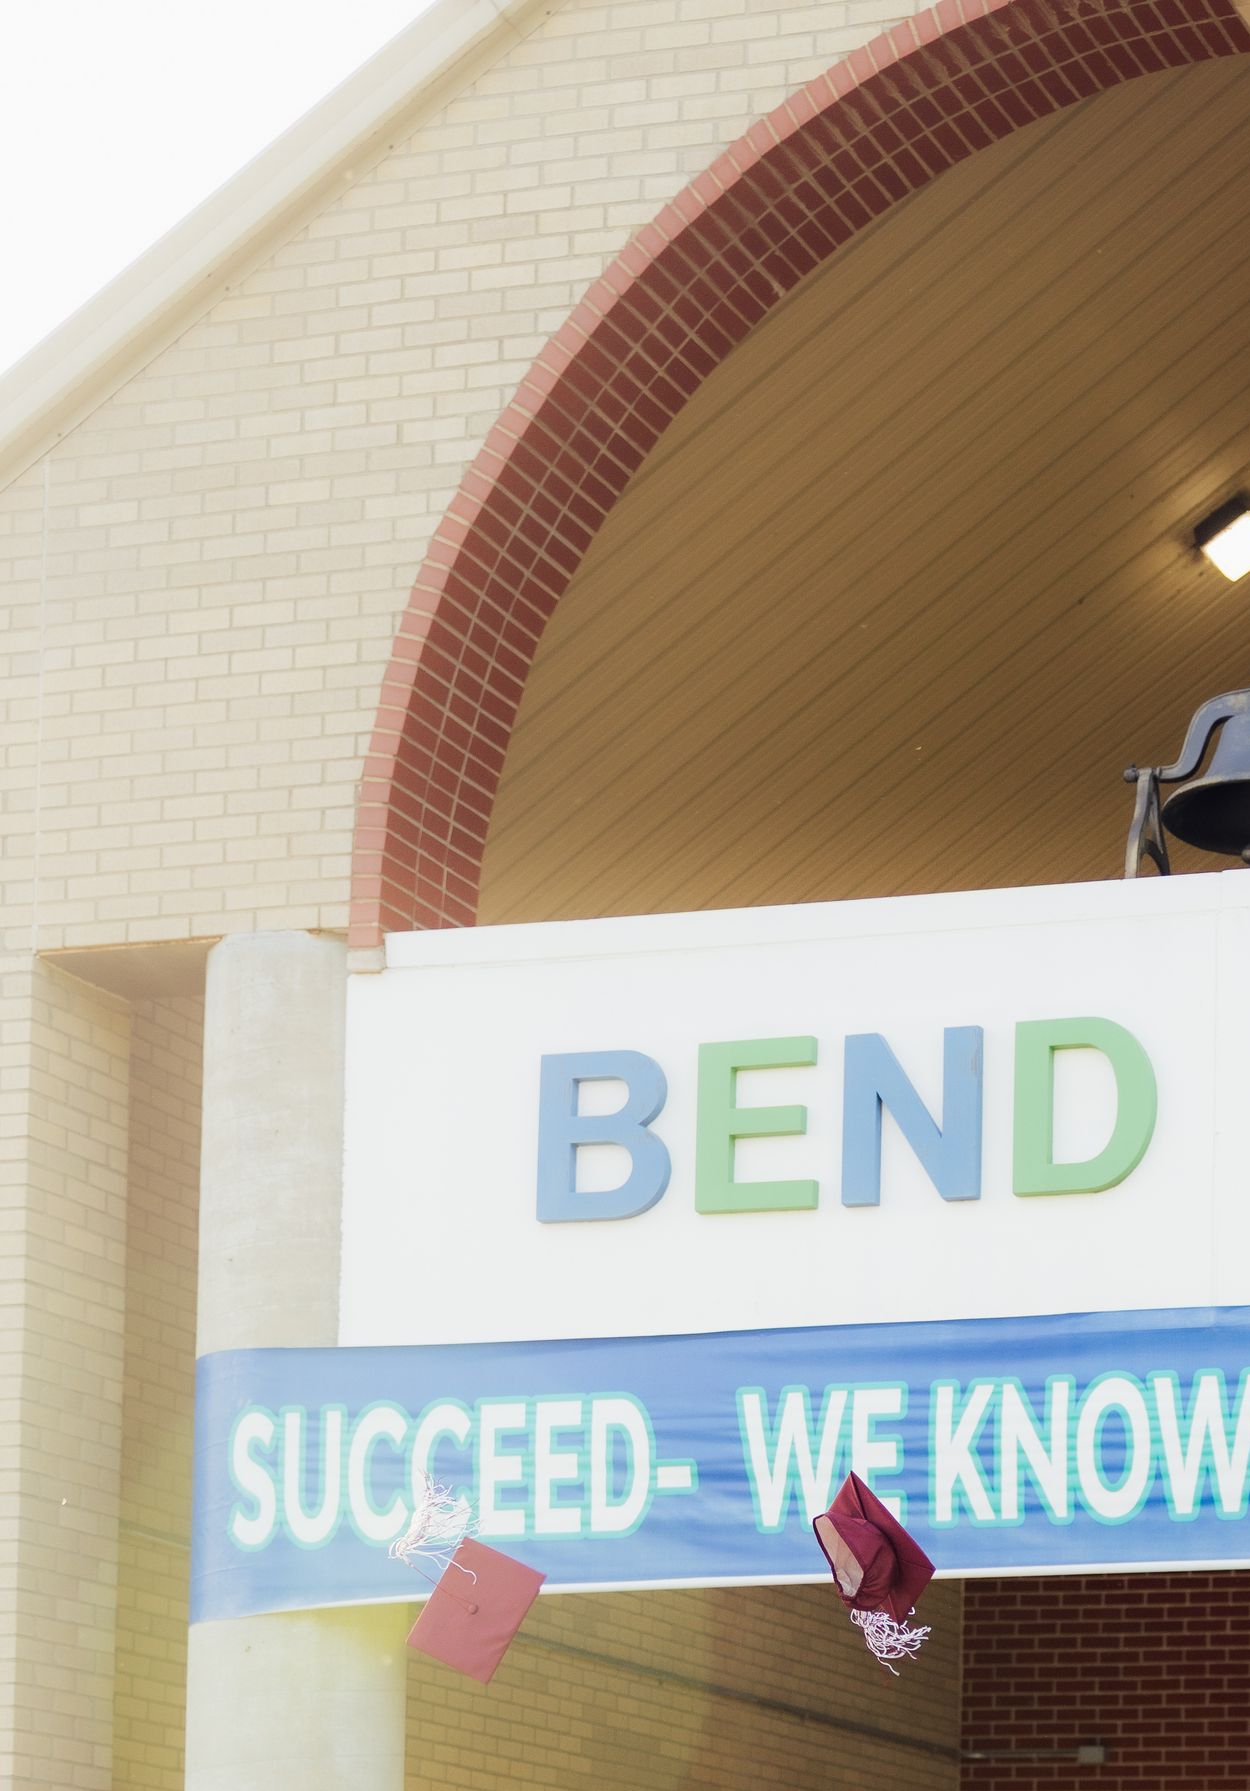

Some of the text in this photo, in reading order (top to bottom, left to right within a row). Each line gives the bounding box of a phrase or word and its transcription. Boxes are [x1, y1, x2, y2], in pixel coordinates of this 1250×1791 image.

[535, 1014, 1159, 1225] BEND
[229, 1393, 697, 1549] SUCCEED-
[737, 1383, 907, 1532] WE
